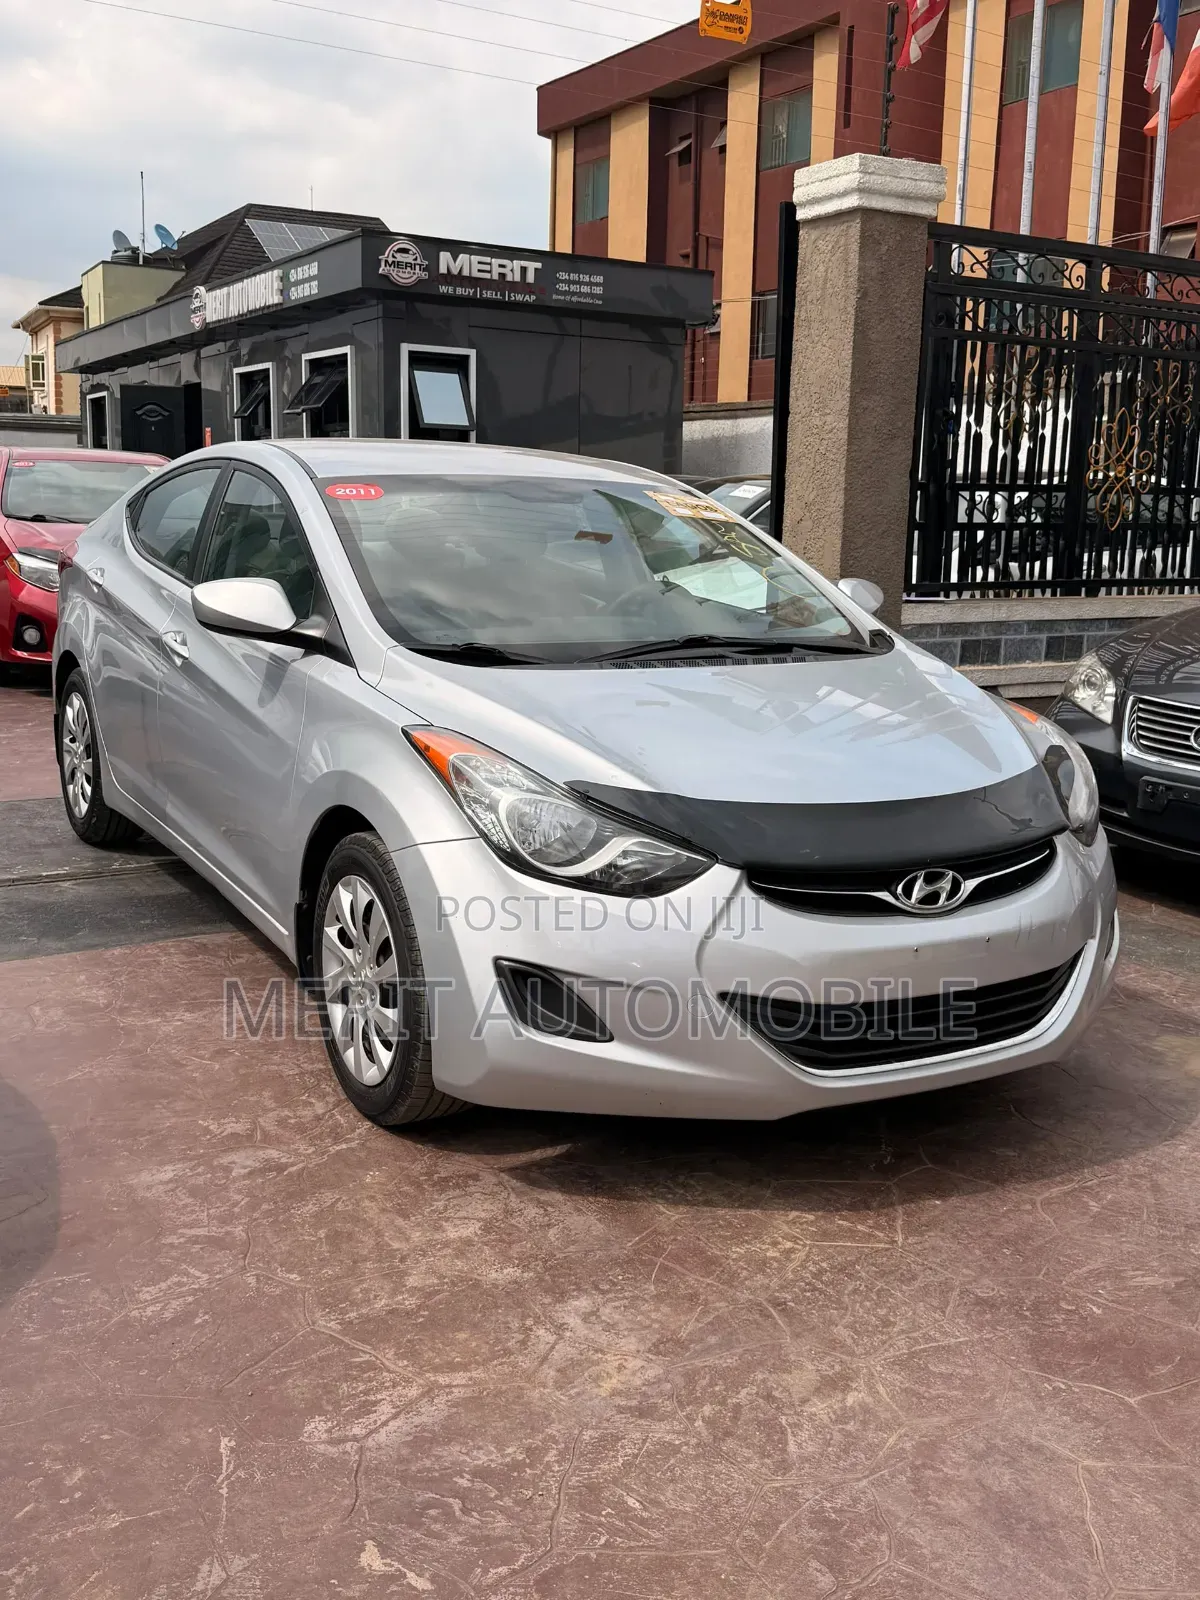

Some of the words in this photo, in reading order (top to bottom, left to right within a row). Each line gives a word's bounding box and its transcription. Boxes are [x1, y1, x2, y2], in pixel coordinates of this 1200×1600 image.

[384, 260, 425, 271] MERIT
[439, 251, 542, 284] MERIT
[229, 270, 283, 318] AUTOMOBILE
[439, 285, 454, 294] WE
[456, 287, 475, 296] BUY
[482, 289, 503, 299] SELL
[510, 292, 536, 302] SWAP
